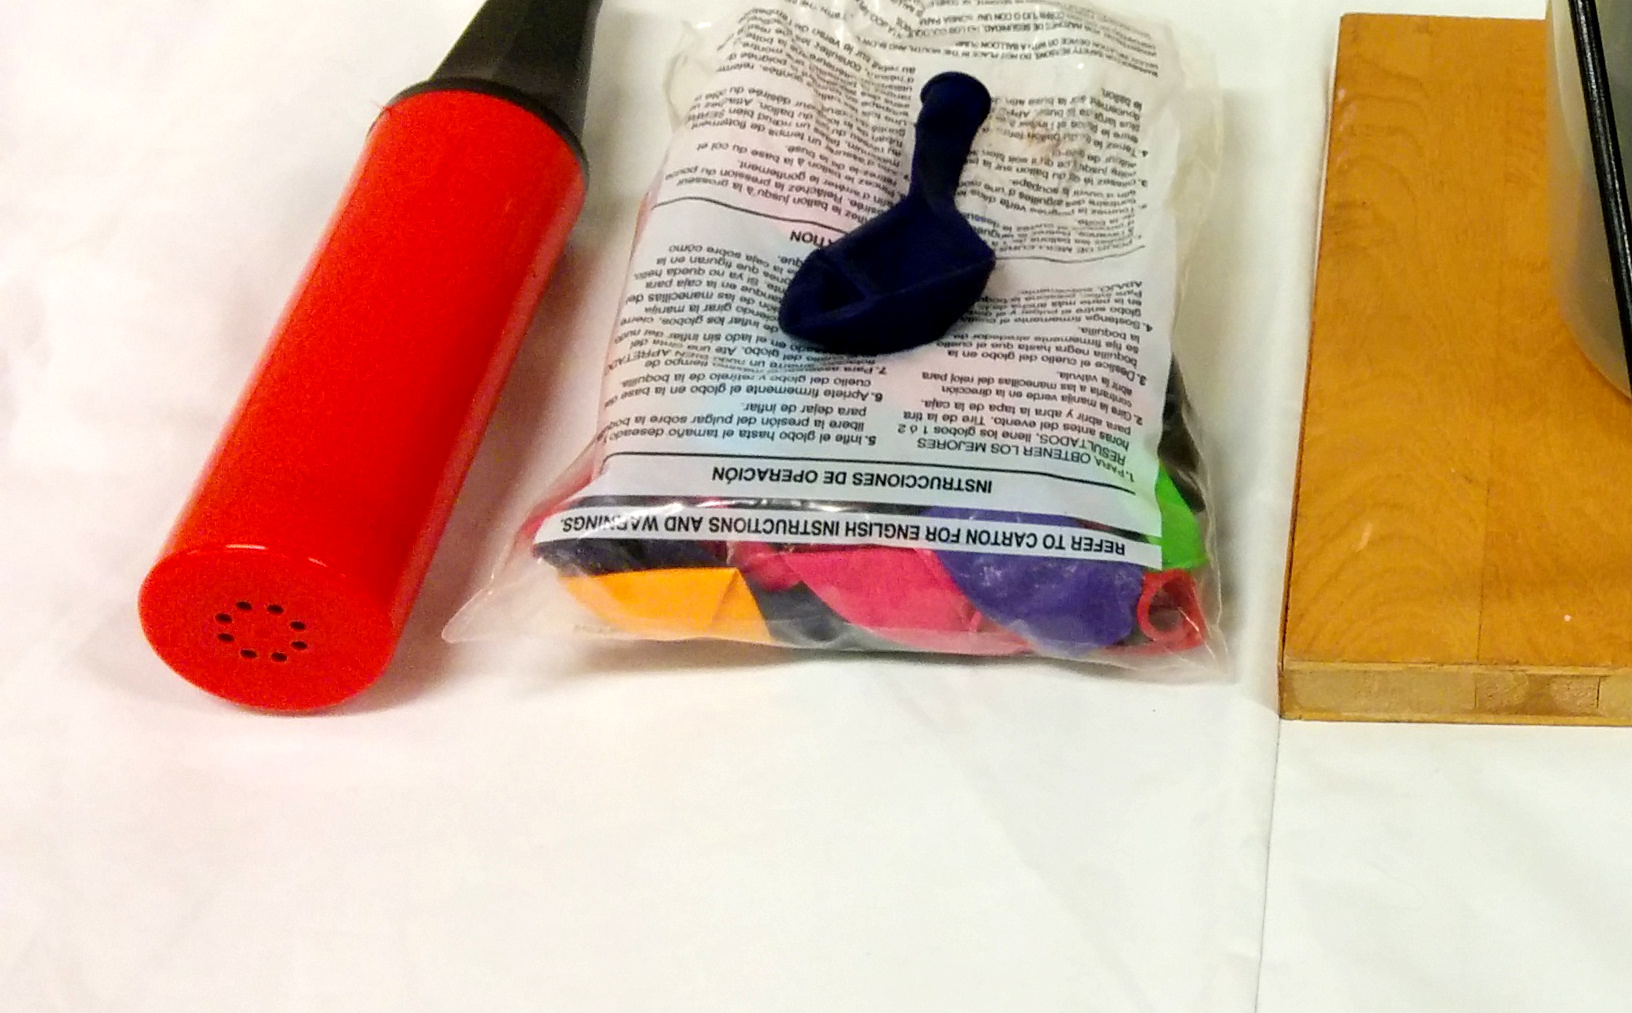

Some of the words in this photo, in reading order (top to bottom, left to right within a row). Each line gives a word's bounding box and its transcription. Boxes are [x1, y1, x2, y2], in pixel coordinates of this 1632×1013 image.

[654, 386, 665, 396] la
[670, 386, 686, 394] en
[691, 384, 726, 394] globo
[730, 385, 742, 395] el
[746, 385, 819, 397] firmemente
[823, 389, 870, 401] Apriete
[941, 385, 992, 399] dirección
[995, 389, 1005, 399] la
[1008, 390, 1023, 400] en
[1025, 391, 1058, 405] verde
[1061, 394, 1097, 410] manija
[781, 404, 796, 414] de
[801, 404, 834, 417] dejar
[921, 398, 951, 411] caja.
[954, 402, 965, 413] la
[968, 403, 984, 415] de
[988, 403, 1016, 417] tapa
[1099, 402, 1109, 415] la
[838, 406, 867, 417] para
[903, 411, 923, 422] tira
[1019, 407, 1031, 417] la
[1034, 408, 1062, 420] abra
[1066, 408, 1073, 420] y
[1111, 405, 1132, 421] Gire
[635, 416, 646, 426] la
[650, 416, 688, 424] sobre
[692, 414, 734, 425] pulgar
[737, 416, 757, 426] del
[761, 417, 810, 428] presión
[927, 413, 938, 423] la
[942, 413, 958, 424] de
[962, 415, 986, 427] Tire
[991, 417, 1036, 430] evento.
[1076, 413, 1103, 428] abrir
[814, 419, 825, 430] la
[829, 419, 864, 432] libere
[897, 423, 906, 433] 2
[923, 425, 928, 434] 1
[1039, 421, 1059, 432] del
[1063, 423, 1096, 438] antes
[1106, 420, 1132, 436] para
[668, 429, 718, 439] tamaño
[722, 429, 734, 439] el
[739, 429, 775, 441] hasta
[779, 431, 815, 442] globo
[934, 425, 976, 439] globos
[979, 429, 997, 439] los
[1001, 430, 1032, 442] llene
[819, 433, 831, 444] el
[835, 434, 862, 445] Infle
[865, 435, 877, 446] 5.
[1099, 431, 1130, 451] horas
[917, 438, 986, 452] MEJORES
[991, 443, 1019, 455] LOS
[1023, 446, 1091, 464] OBTENER
[1094, 458, 1125, 477] PARA
[712, 467, 818, 484] OPERACIÓN
[824, 471, 846, 483] DE
[852, 472, 992, 493] INSTRUCCIONES
[664, 516, 703, 532] AND
[709, 516, 840, 536] INSTRUCTIONS
[846, 521, 920, 540] ENGLISH
[925, 526, 961, 543] FOR
[967, 528, 1037, 548] CARTON
[1043, 534, 1065, 550] TO
[1072, 536, 1125, 555] REFER
